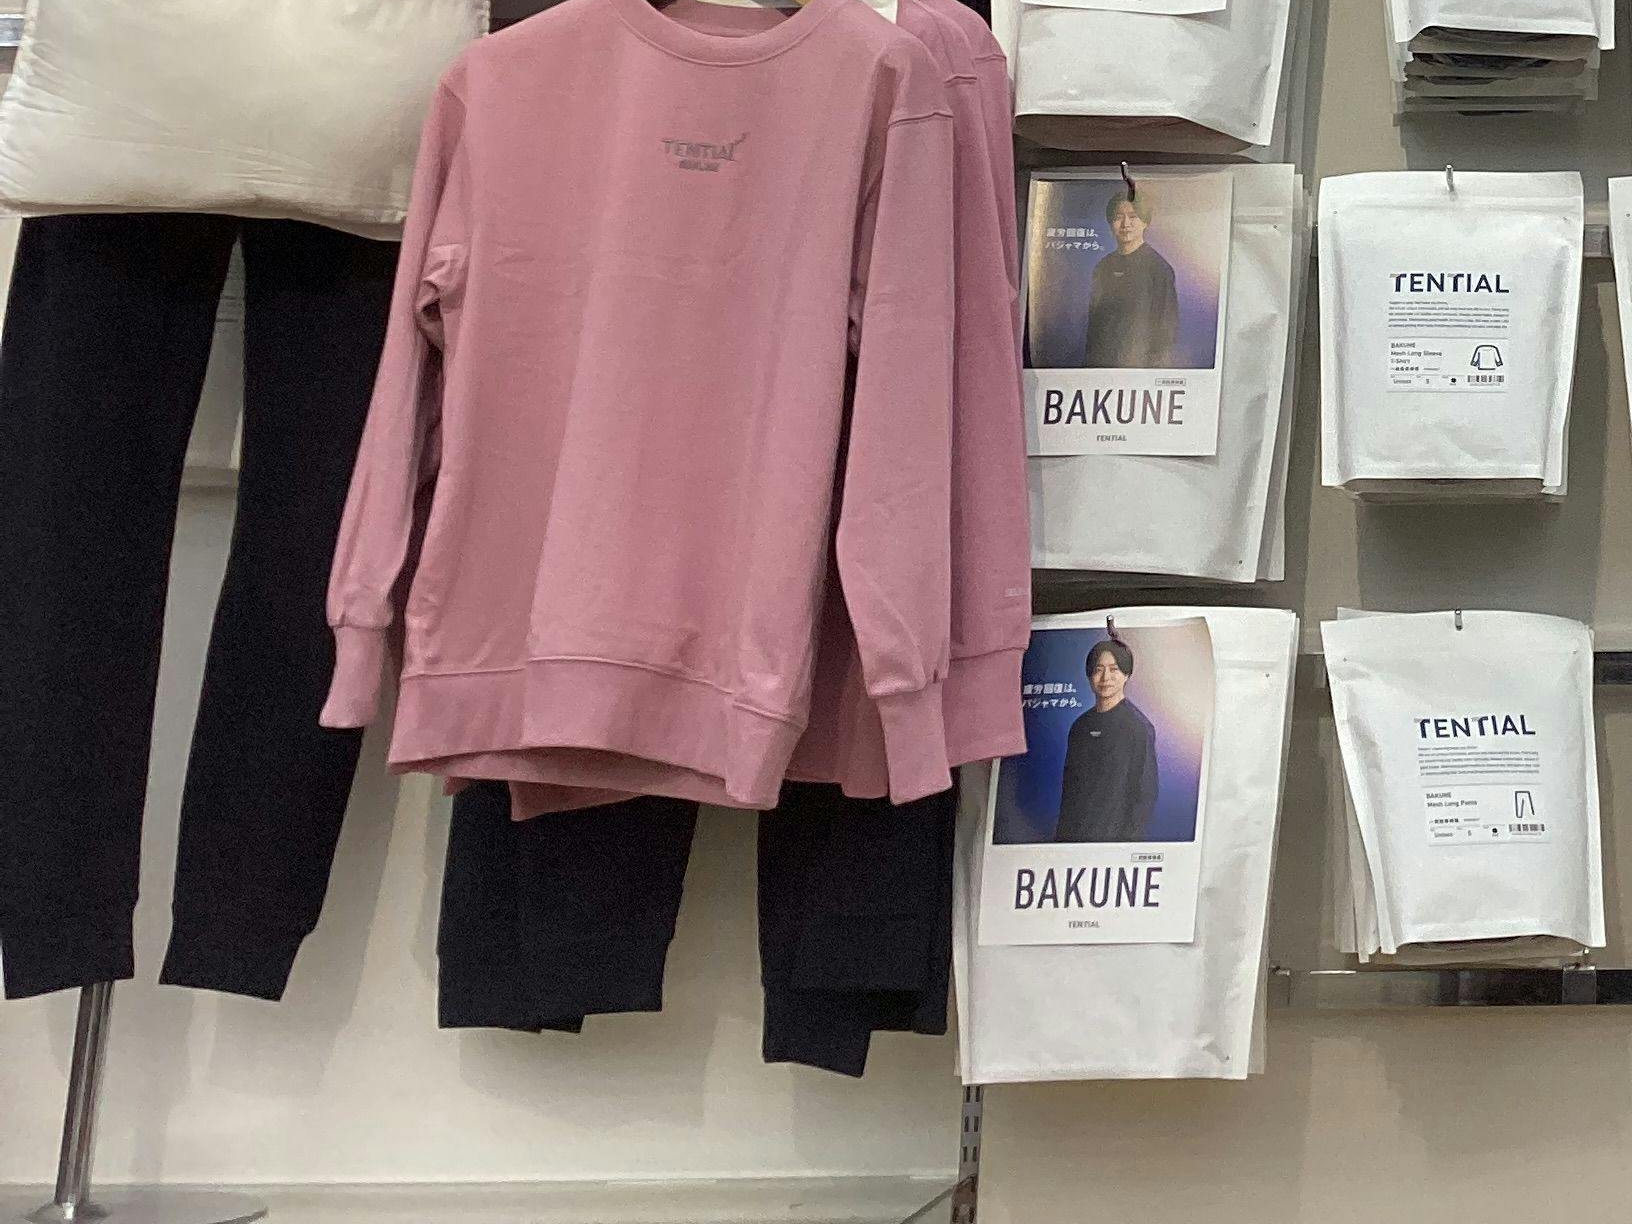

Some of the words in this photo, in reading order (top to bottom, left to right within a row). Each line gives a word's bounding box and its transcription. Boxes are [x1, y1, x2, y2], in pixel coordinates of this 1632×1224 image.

[1389, 272, 1510, 294] TENTIAL
[1043, 389, 1186, 426] BAKUNE
[1413, 714, 1537, 739] TENTIAL
[1014, 866, 1164, 910] BAKUNE
